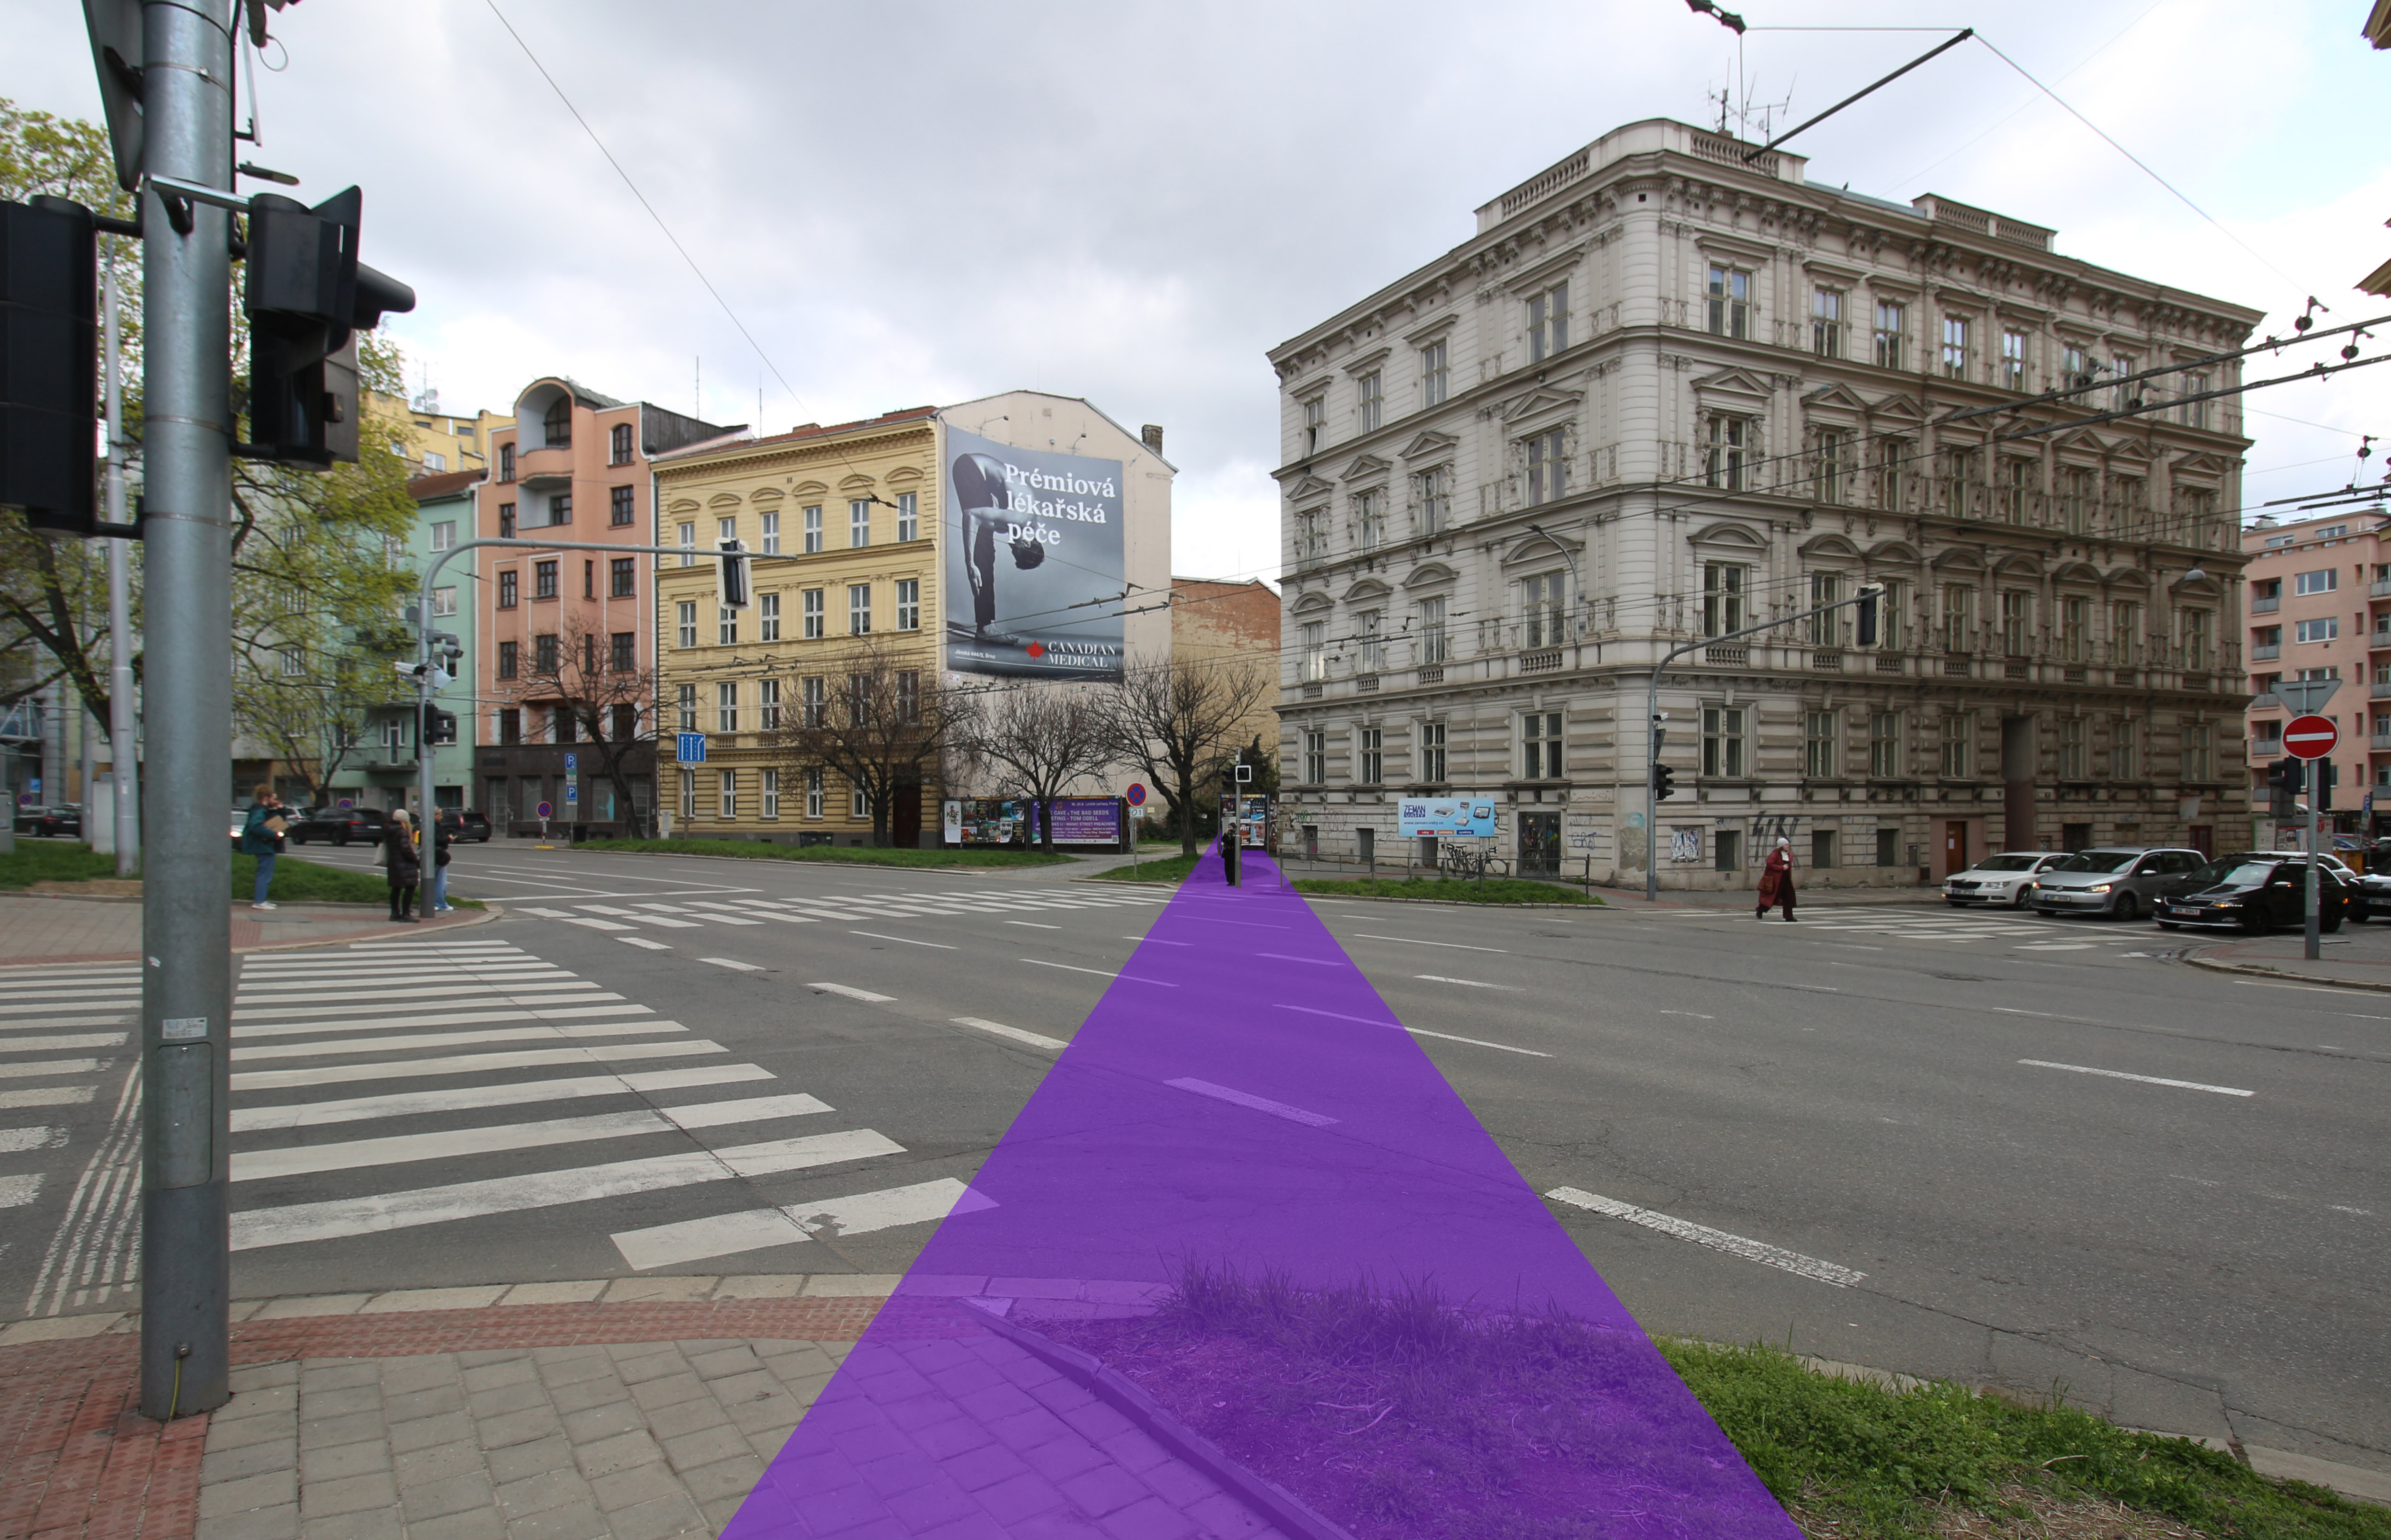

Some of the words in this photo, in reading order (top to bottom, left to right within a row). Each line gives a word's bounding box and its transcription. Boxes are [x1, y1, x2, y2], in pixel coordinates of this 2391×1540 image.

[1004, 463, 1116, 498] Prémiová
[1006, 490, 1107, 524] lékařská
[1007, 521, 1061, 545] péče
[1048, 641, 1116, 656] CANADIAN
[1048, 654, 1108, 668] MEDICAL
[568, 756, 574, 765] P
[569, 788, 575, 797] P
[1404, 805, 1425, 814] ZEMAN
